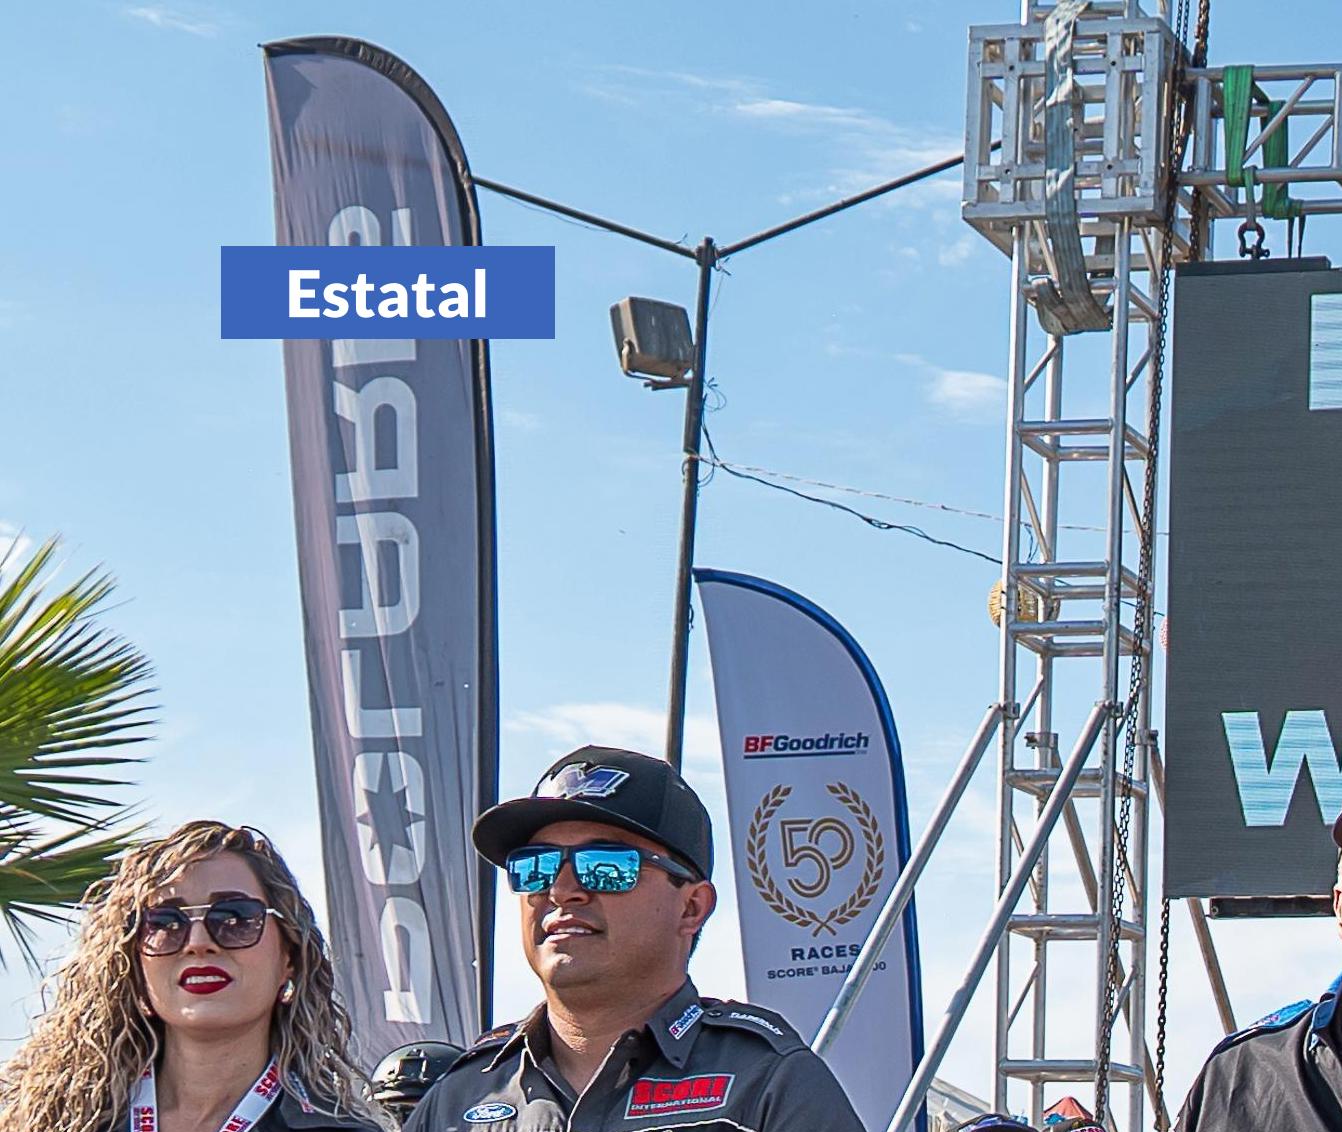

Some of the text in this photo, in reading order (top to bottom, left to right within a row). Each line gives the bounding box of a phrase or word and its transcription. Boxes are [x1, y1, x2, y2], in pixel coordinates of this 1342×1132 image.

[744, 733, 870, 753] BFGoodrich
[780, 817, 855, 898] 50
[791, 944, 861, 961] RACES
